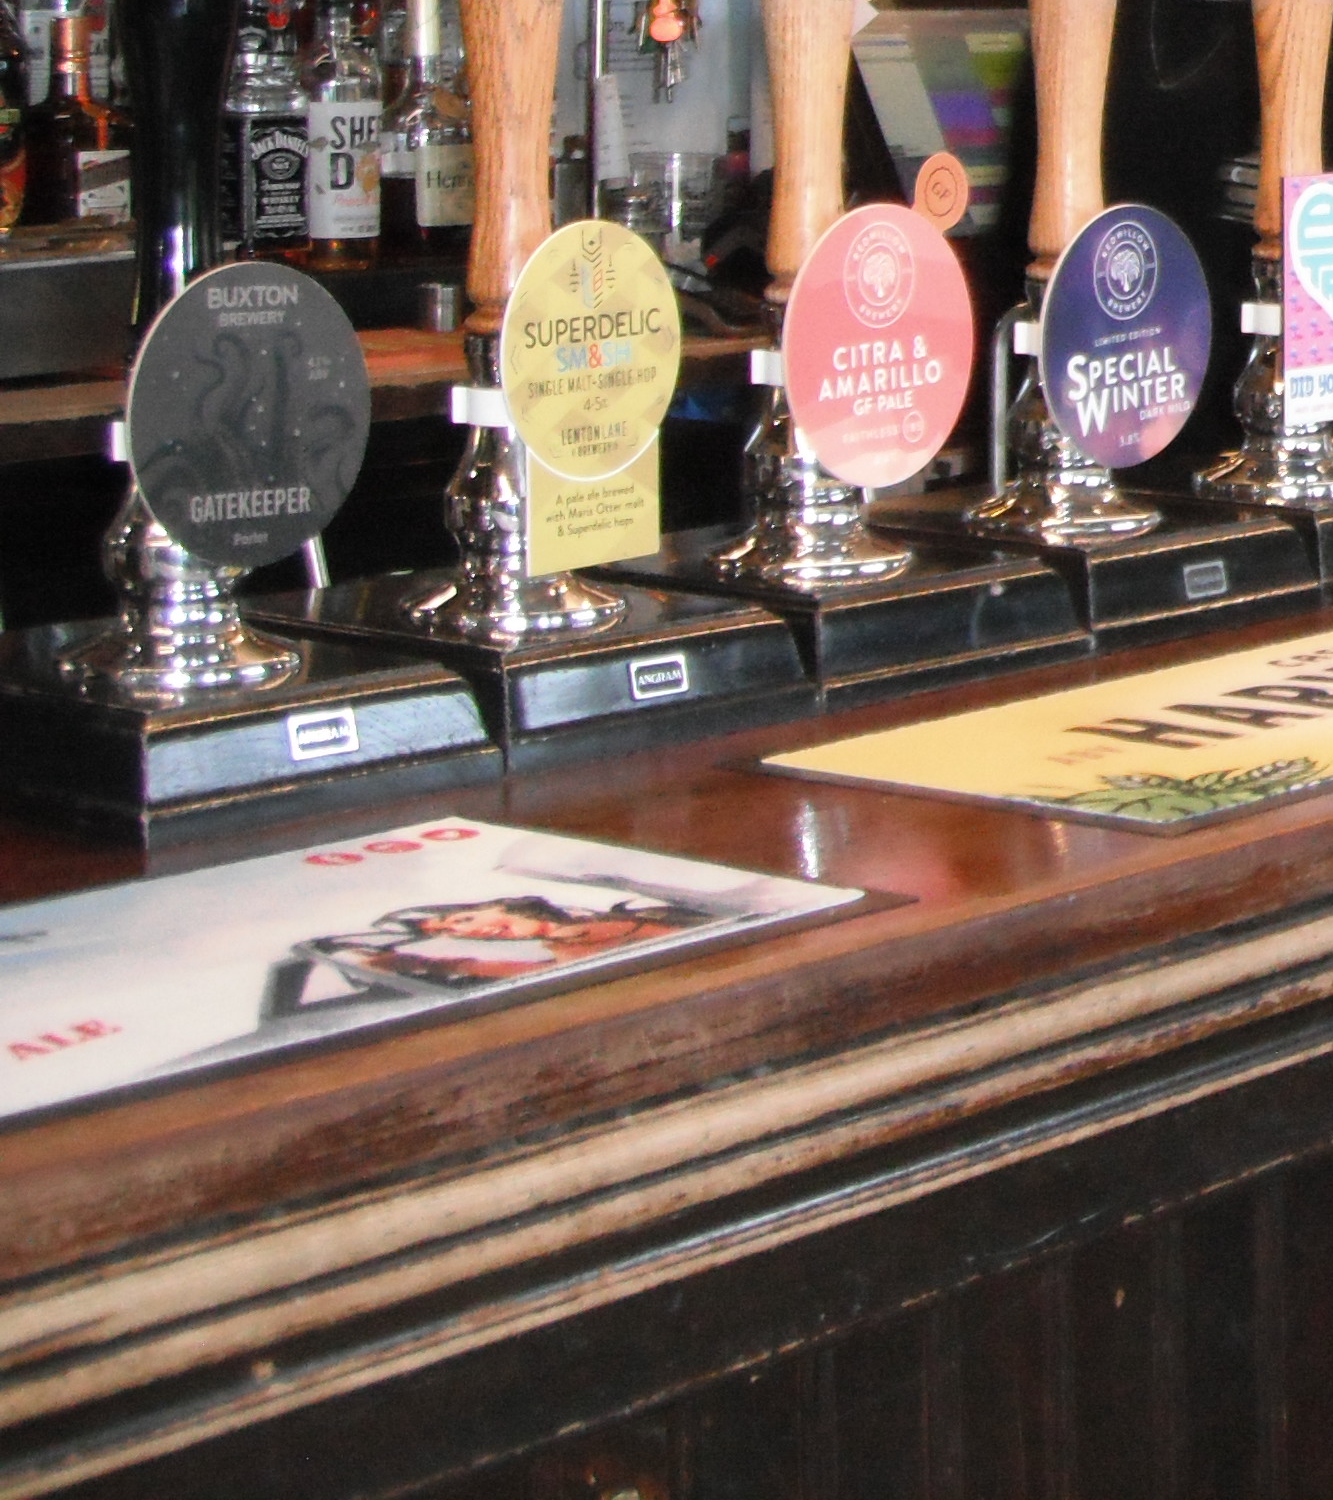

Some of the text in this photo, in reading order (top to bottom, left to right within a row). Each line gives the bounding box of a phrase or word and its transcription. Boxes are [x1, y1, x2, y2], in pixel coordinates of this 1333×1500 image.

[207, 284, 299, 309] BUXTON
[218, 310, 286, 328] BREWERY
[523, 307, 663, 349] SUPERDELIC
[832, 334, 928, 372] CITRA &
[528, 366, 657, 400] SINGLE HOP
[817, 358, 943, 402] AMARILLO
[1066, 346, 1177, 402] SPECIAL
[1289, 374, 1314, 399] DID
[852, 390, 914, 417] GF PALE
[1075, 372, 1187, 438] WINTER
[1139, 405, 1166, 422] DARK
[561, 420, 628, 446] LENTON LANE
[189, 485, 312, 523] GATEKEEPER
